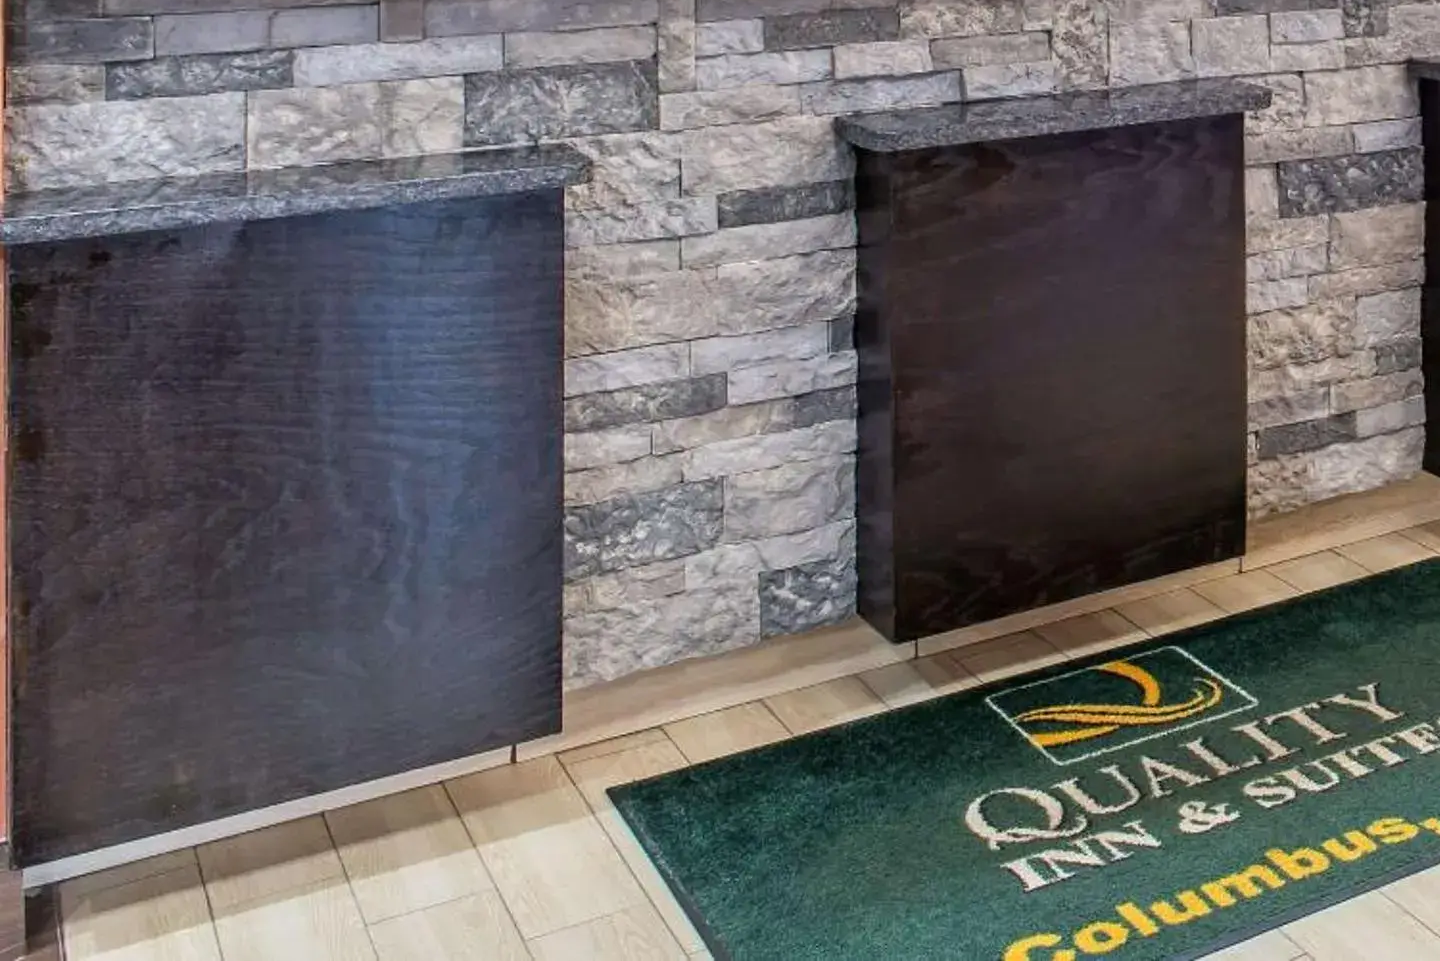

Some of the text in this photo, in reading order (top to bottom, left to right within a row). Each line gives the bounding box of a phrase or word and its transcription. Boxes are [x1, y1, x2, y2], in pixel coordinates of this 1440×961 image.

[965, 682, 1405, 851] QUALITY
[1000, 819, 1163, 893] INN
[1177, 800, 1241, 835] &
